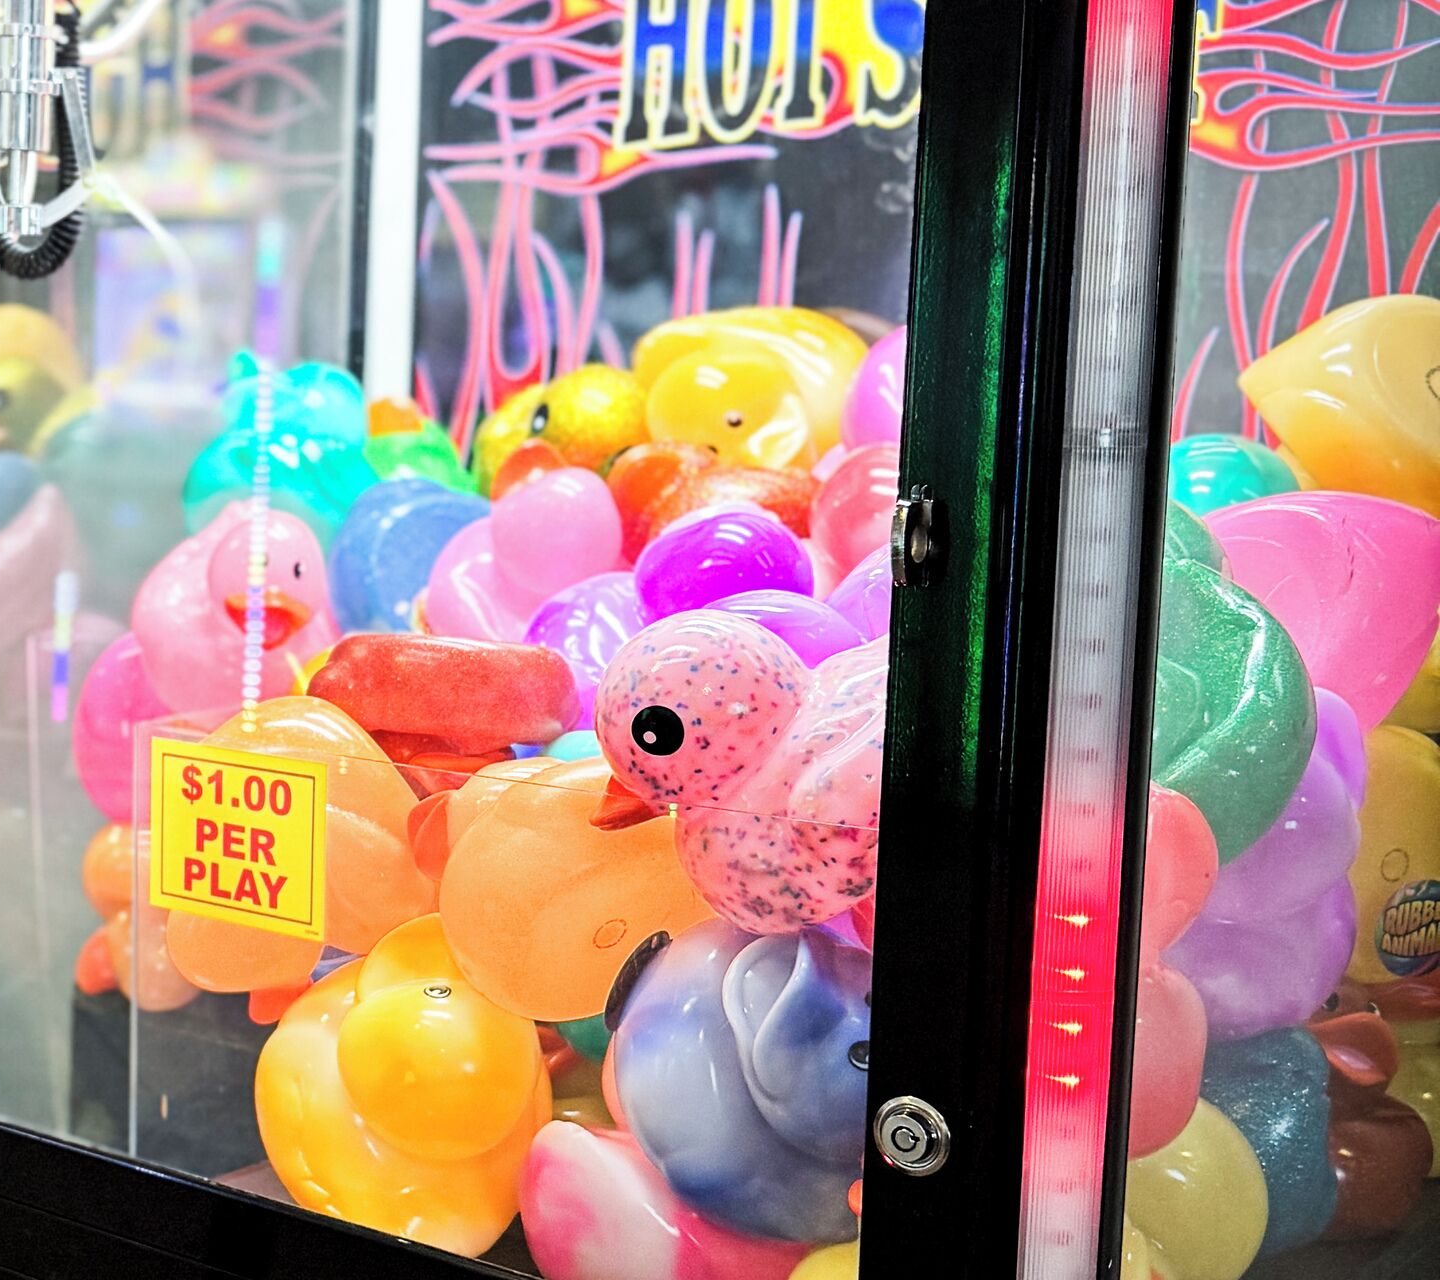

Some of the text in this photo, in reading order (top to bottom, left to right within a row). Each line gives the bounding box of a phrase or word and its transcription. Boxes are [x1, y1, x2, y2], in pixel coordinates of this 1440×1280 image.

[181, 763, 292, 816] $1.00
[195, 818, 277, 867] PER
[183, 856, 289, 910] PLAY
